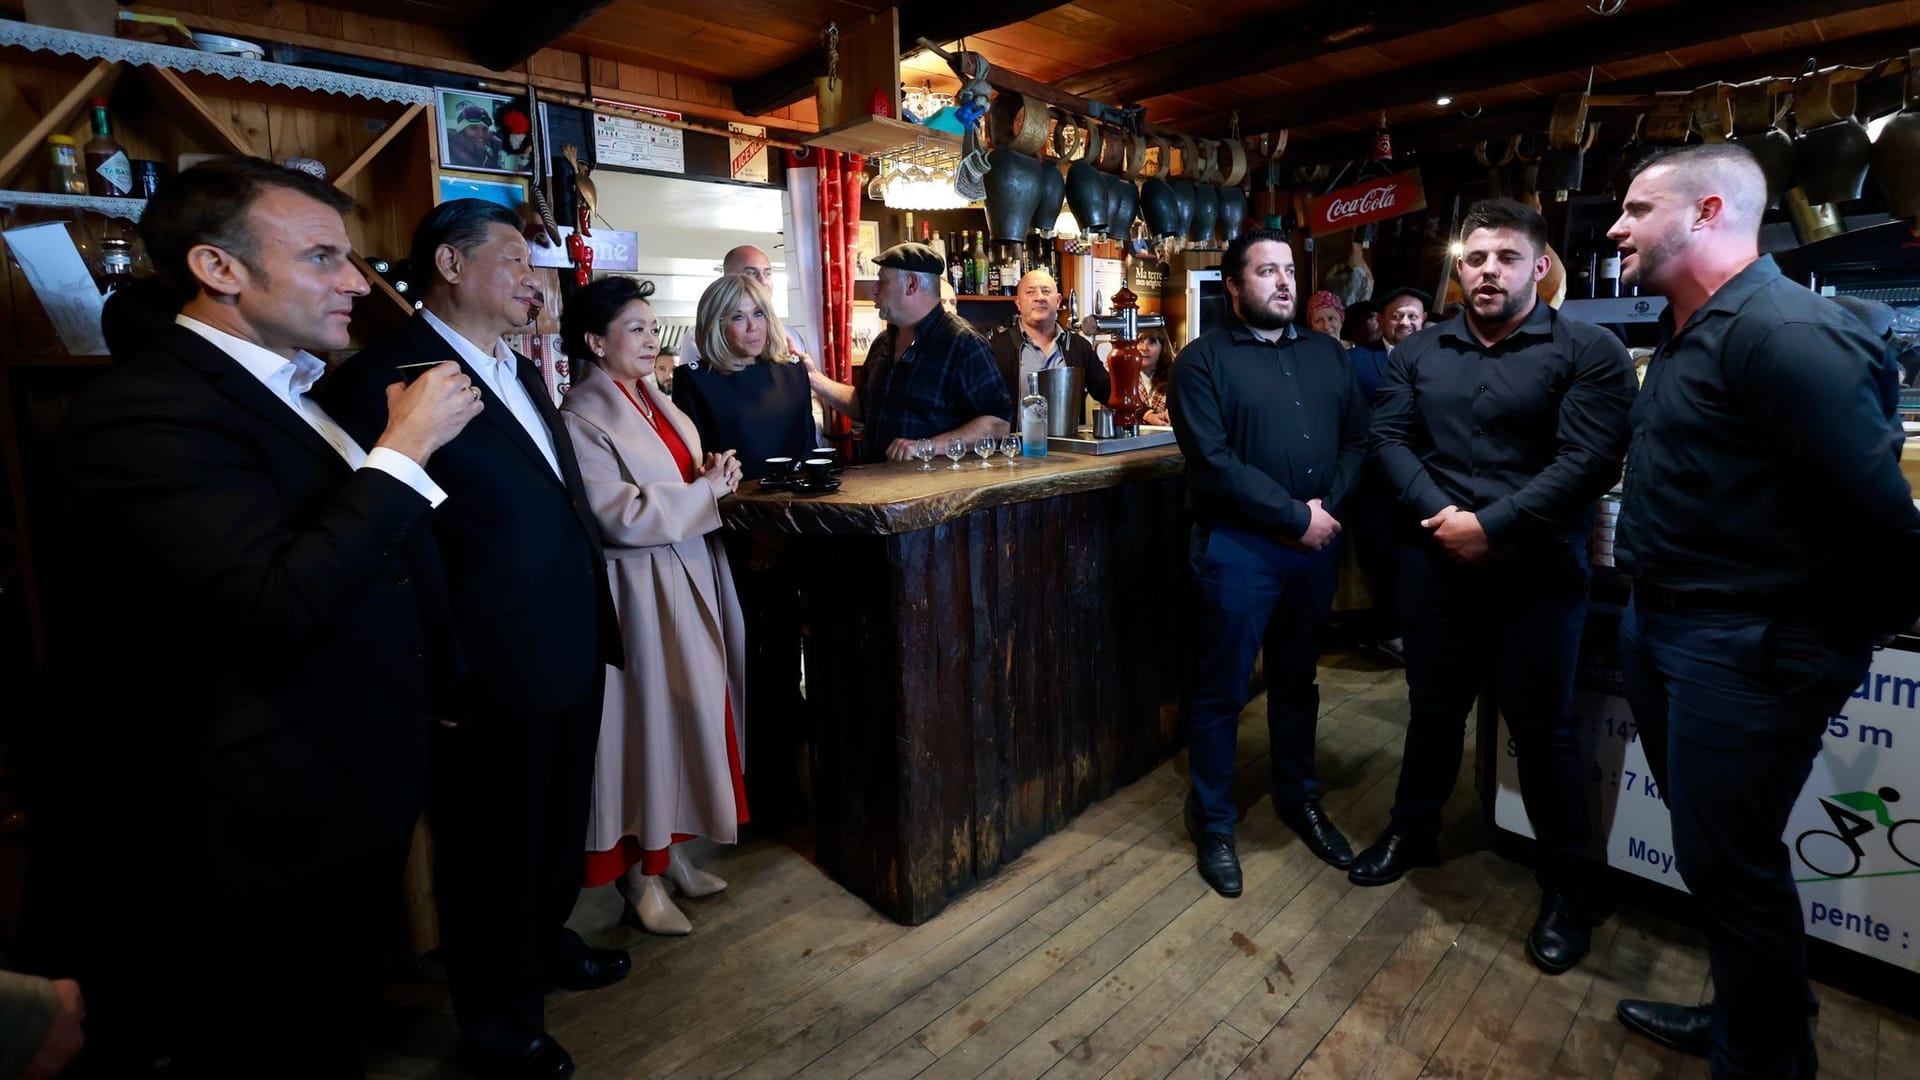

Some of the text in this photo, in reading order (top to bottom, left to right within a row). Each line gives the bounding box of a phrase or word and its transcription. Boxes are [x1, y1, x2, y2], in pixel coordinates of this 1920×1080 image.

[735, 133, 764, 172] LICENC
[1325, 184, 1398, 223] Coca-Cola
[1135, 267, 1148, 280] Ma
[1858, 725, 1894, 749] m
[1644, 775, 1664, 800] k
[1629, 837, 1674, 874] Moy
[1811, 900, 1891, 942] pente
